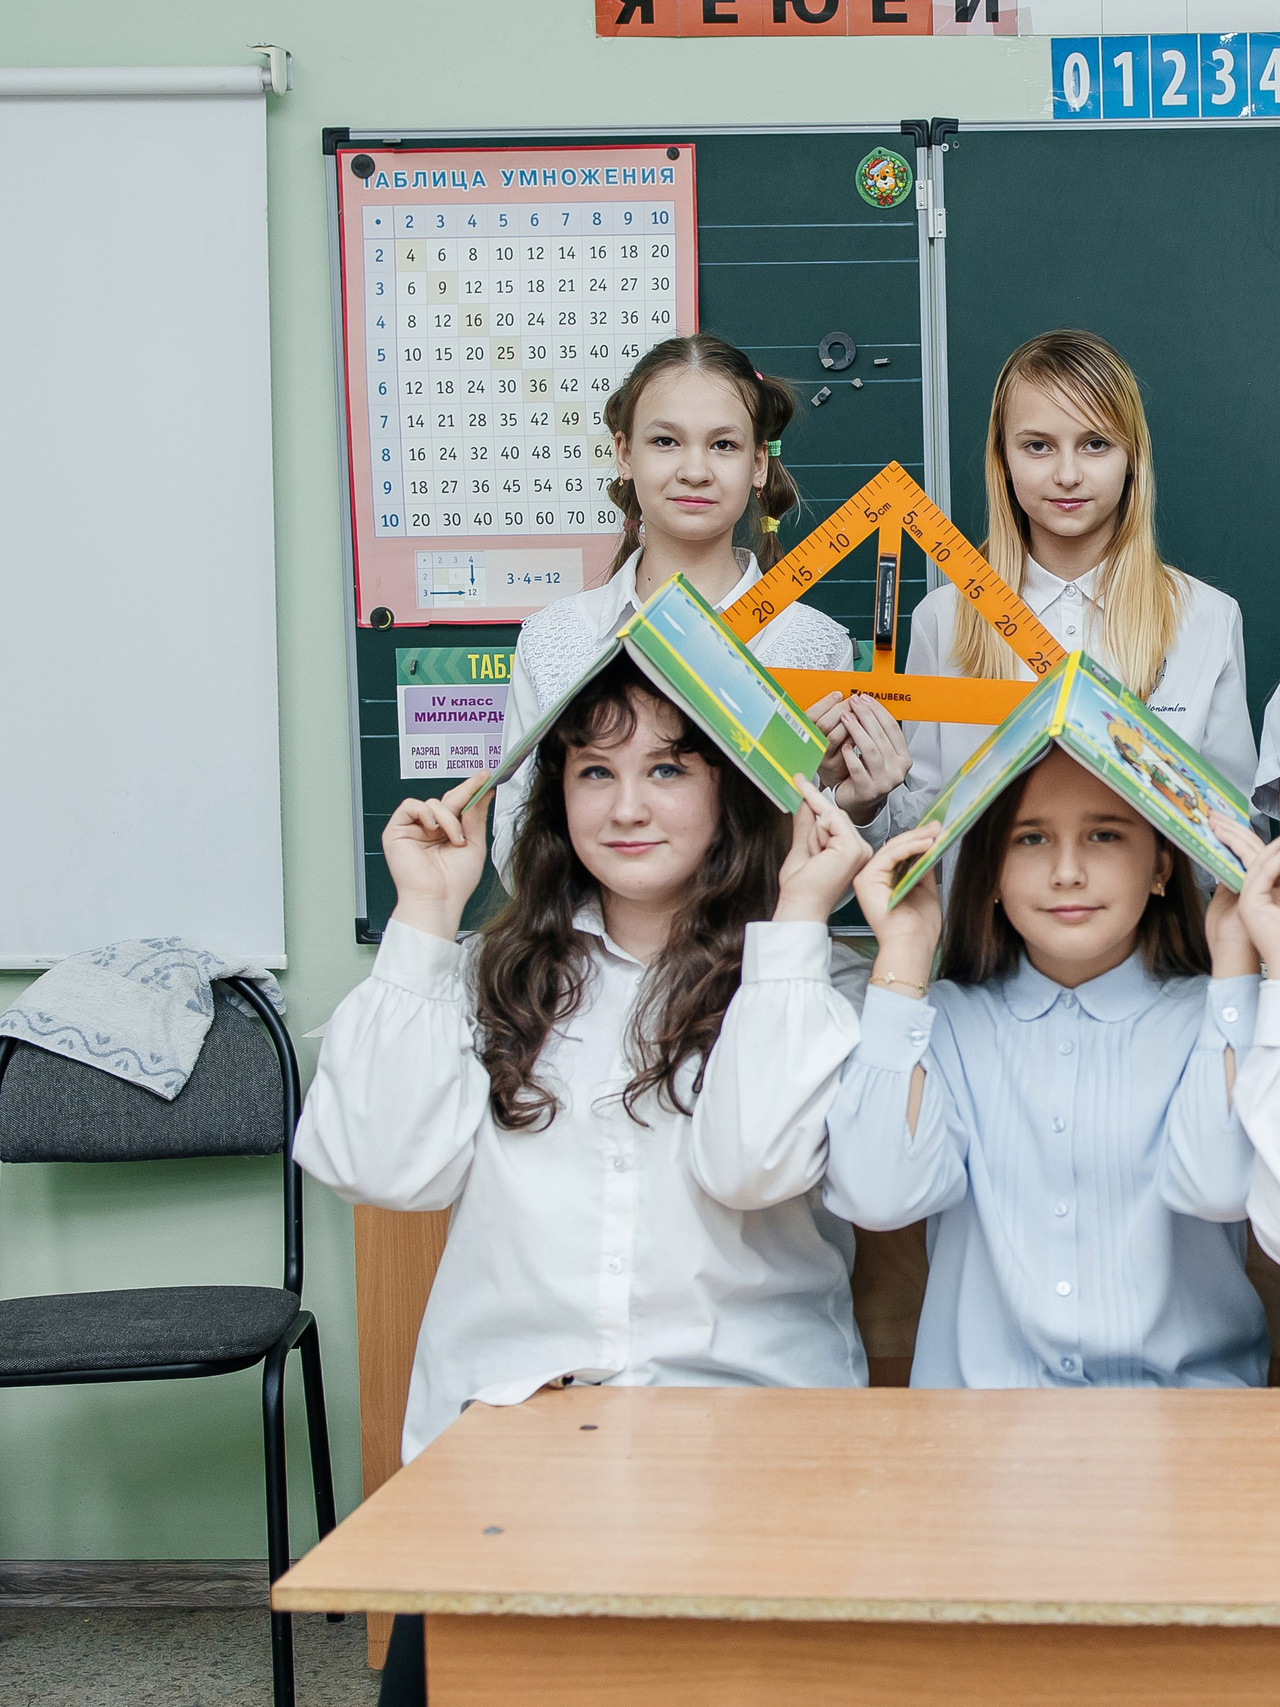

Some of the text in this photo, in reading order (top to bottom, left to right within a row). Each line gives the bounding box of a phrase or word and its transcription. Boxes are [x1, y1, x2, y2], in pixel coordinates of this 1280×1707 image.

[1063, 52, 1090, 112] 0
[1113, 51, 1134, 108] 1
[1161, 49, 1189, 107] 2
[1210, 48, 1237, 106] 3
[500, 167, 675, 188] УМНОЖЕНИЯ
[405, 210, 670, 229] 2 3 4 5 6 7 8 9 10
[375, 244, 670, 263] 2 4 6 8 10 12 14 16 18 20
[375, 276, 670, 296] 3 6 9 12 15 18 21 24 27 30
[375, 309, 671, 330] 4 8 12 16 20 24 28 32 36 40
[377, 343, 640, 363] 5 10 15 20 25 30 35 40 45
[378, 377, 611, 396] 6 12 18 24 30 36 42 48
[379, 411, 580, 429] 7 14 21 28 35 42 49
[381, 444, 613, 462] 8 16 24 32 40 48 56 64
[382, 477, 583, 495] 9 18 27 36 45 54 63
[380, 510, 617, 528] 10 20 30 40 50 60 70 80
[751, 600, 775, 624] 20
[791, 565, 813, 588] 15
[828, 533, 851, 554] 10
[930, 540, 951, 563] 10
[963, 577, 985, 600] 15
[994, 614, 1018, 637] 20
[1027, 651, 1052, 675] 25
[431, 696, 494, 707] IV класс
[411, 746, 441, 756] РАЗРЯД
[450, 746, 479, 755] РАЗРЯД
[414, 760, 438, 770] СОТЕН
[446, 759, 484, 770] ДЕСЯТКОВ
